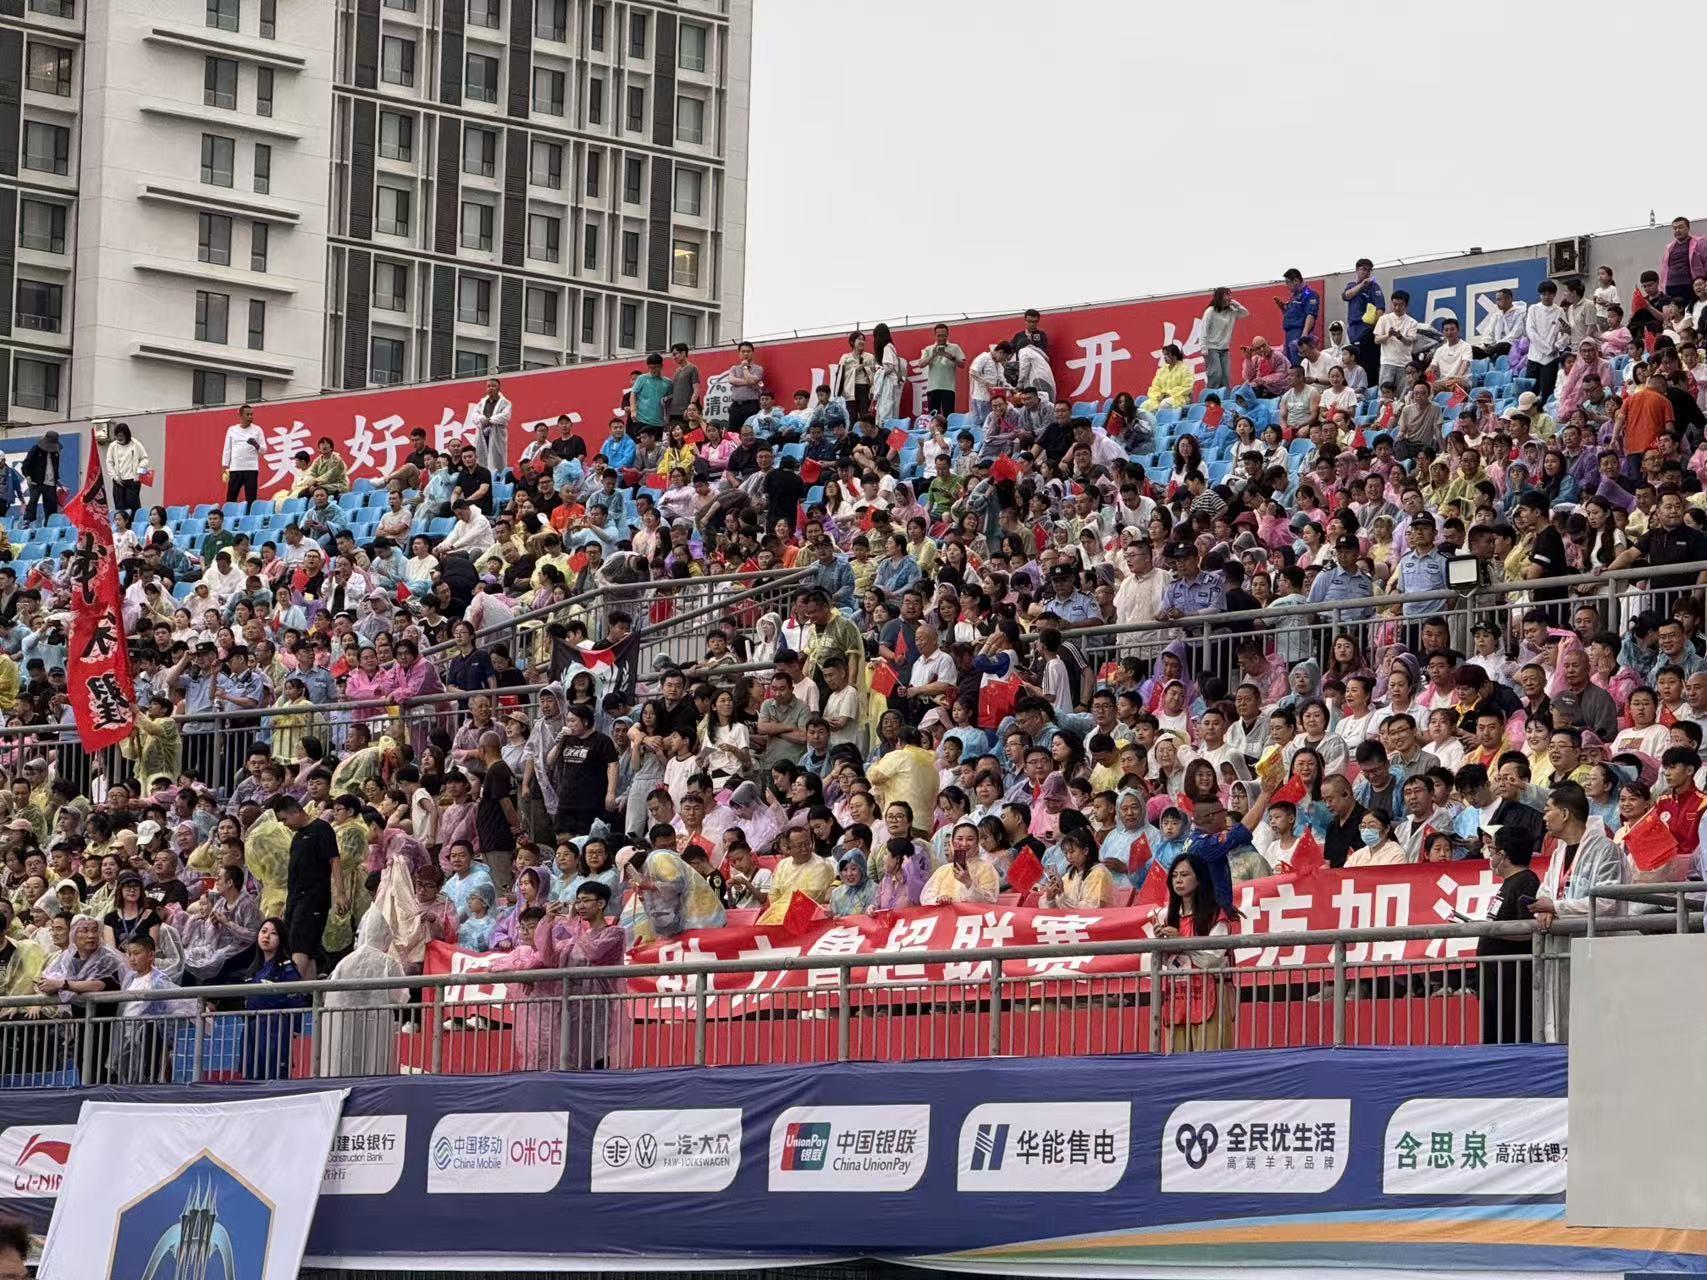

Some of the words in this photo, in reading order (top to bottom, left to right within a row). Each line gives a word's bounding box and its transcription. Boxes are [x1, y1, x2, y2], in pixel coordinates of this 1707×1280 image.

[331, 1134, 396, 1152] 建设银行
[786, 1134, 827, 1150] UnionPay
[836, 1129, 918, 1155] 中国银联
[1016, 1128, 1116, 1165] 华能售电
[1226, 1122, 1336, 1153] 全民优生活
[367, 1152, 384, 1162] Bank
[453, 1135, 502, 1155] 中国移动
[511, 1137, 563, 1166] 咪咕
[801, 1148, 823, 1161] 银联
[1395, 1130, 1489, 1170] 含思泉
[453, 1158, 475, 1169] China
[476, 1157, 502, 1169] Mobile
[833, 1157, 860, 1171] China
[863, 1157, 911, 1175] UnionPay
[1226, 1155, 1335, 1170] 高端羊乳品牌
